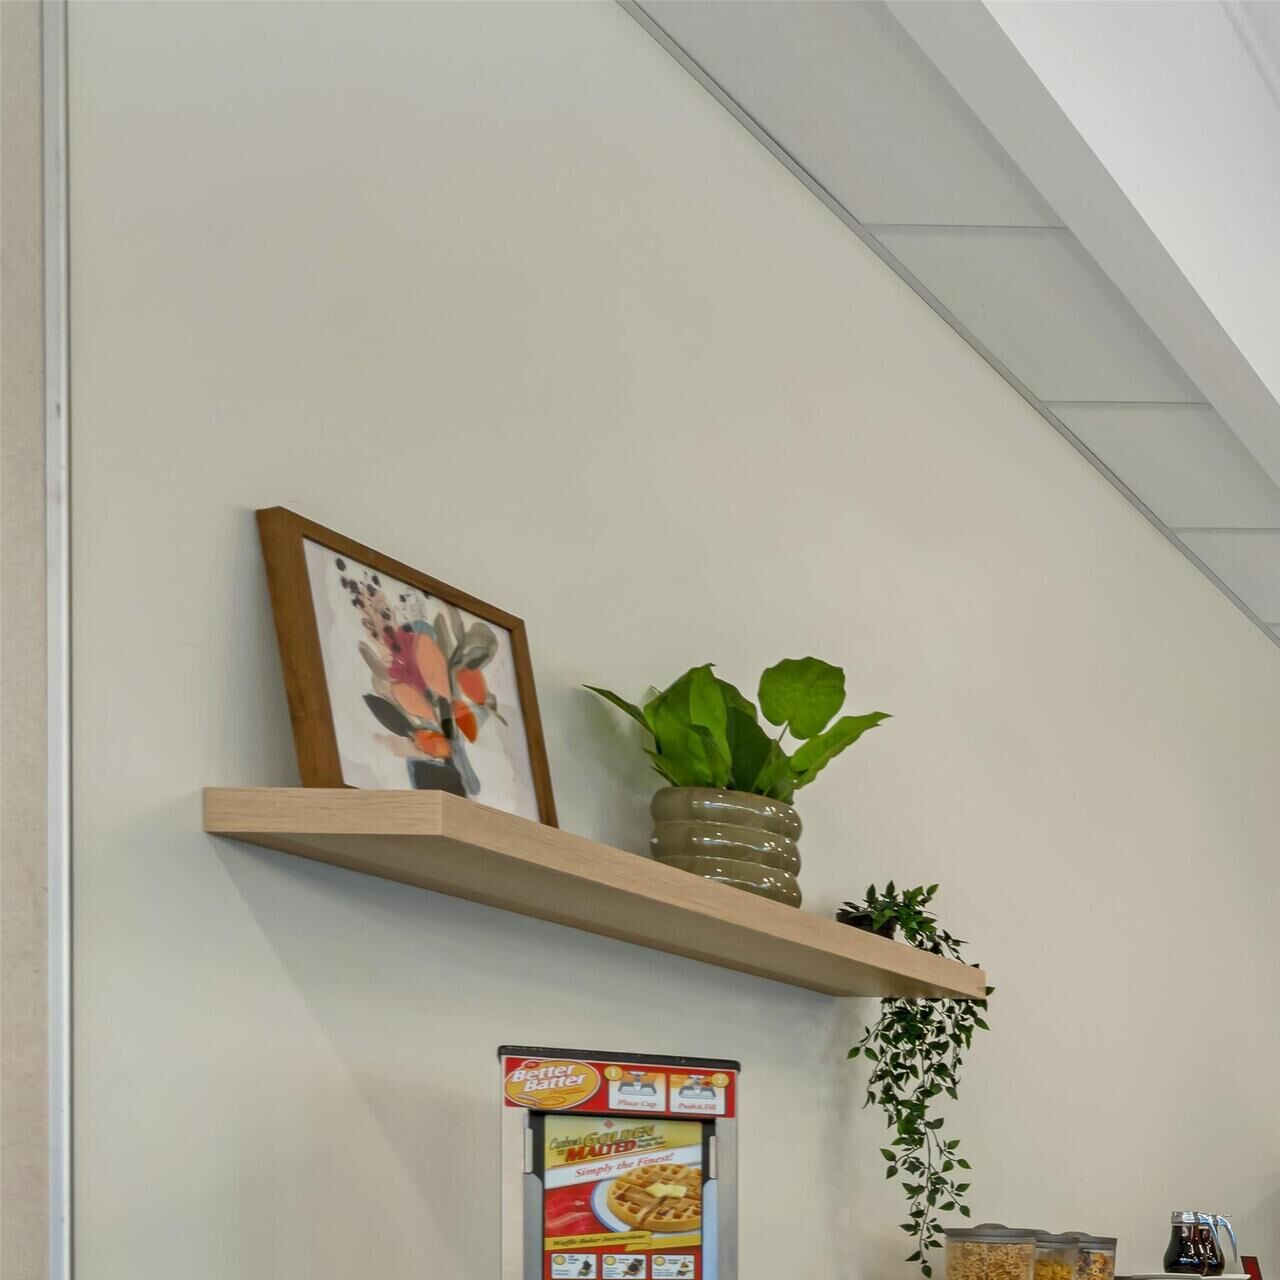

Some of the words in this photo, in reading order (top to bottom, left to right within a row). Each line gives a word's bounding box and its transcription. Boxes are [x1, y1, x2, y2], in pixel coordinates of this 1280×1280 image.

[512, 1063, 575, 1084] Better
[523, 1073, 586, 1092] Batter
[717, 1075, 724, 1085] 2
[618, 1099, 641, 1108] Place
[642, 1100, 657, 1110] Cup
[583, 1124, 656, 1145] GOLDEN
[565, 1139, 637, 1162] MALTED
[575, 1161, 613, 1178] Simply
[616, 1158, 635, 1170] the
[637, 1152, 675, 1167] Finest!
